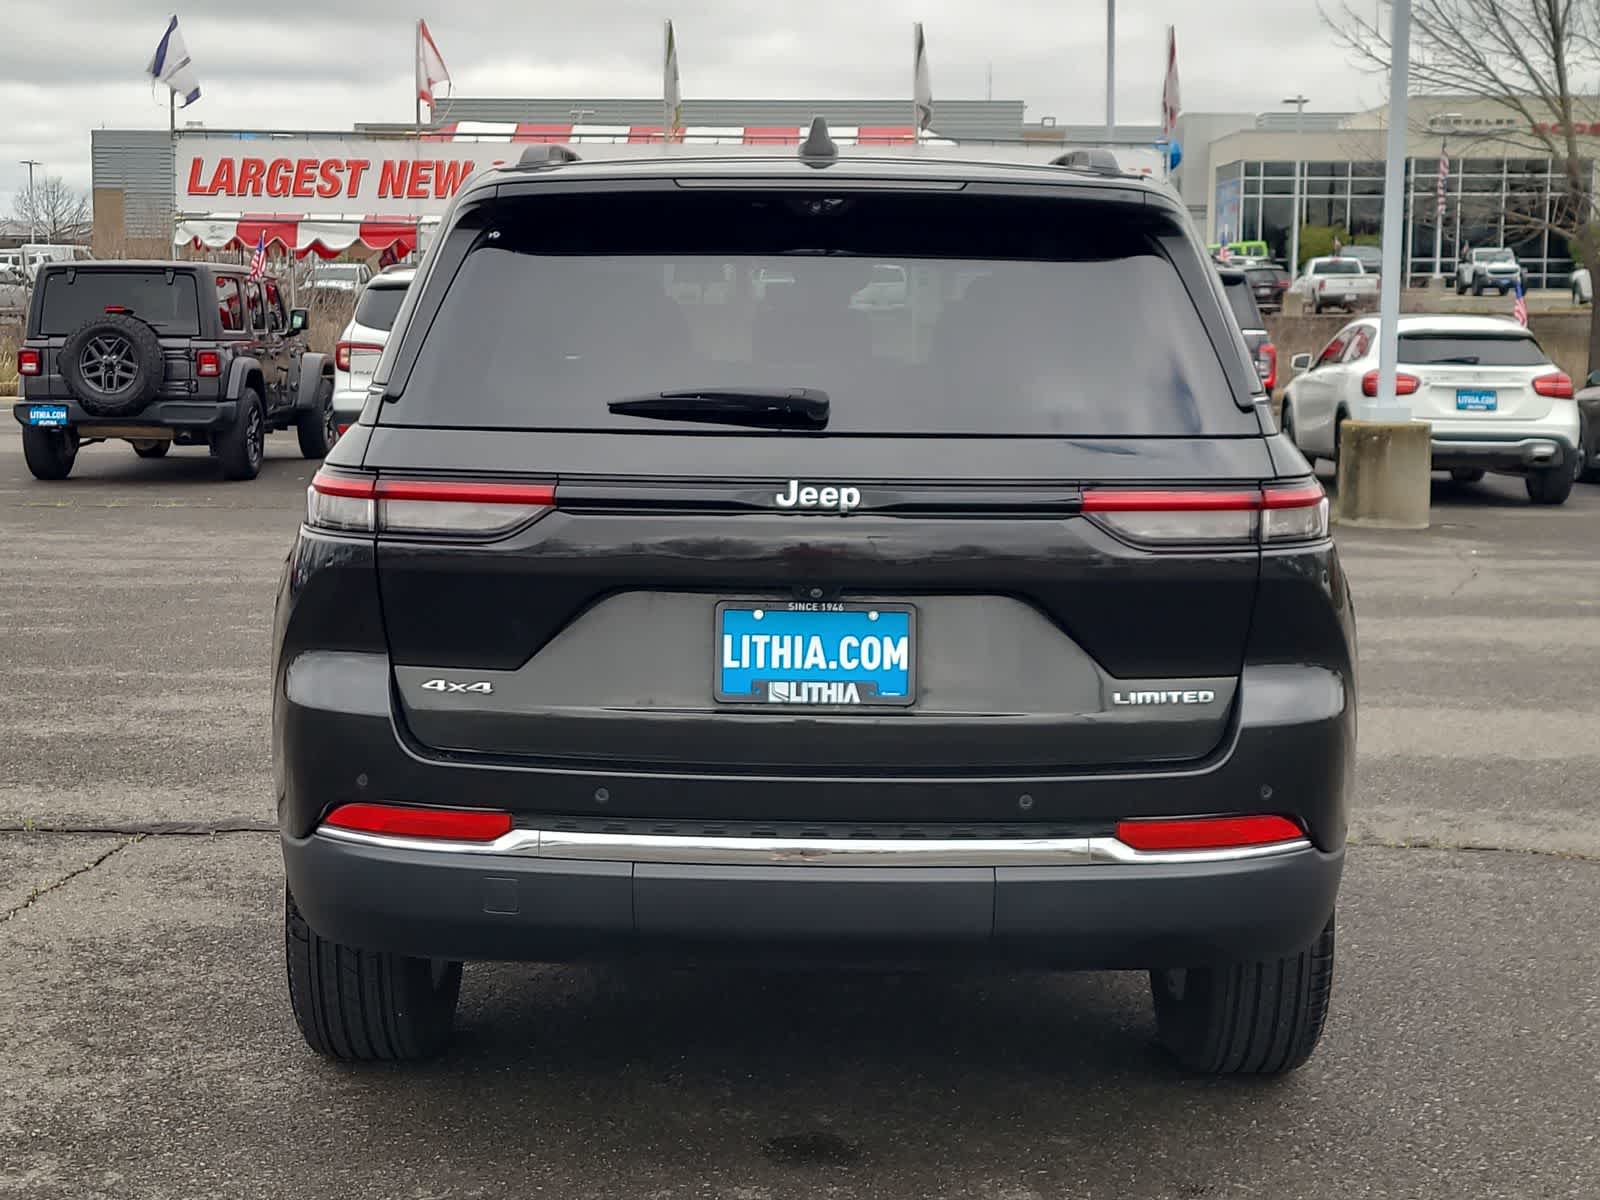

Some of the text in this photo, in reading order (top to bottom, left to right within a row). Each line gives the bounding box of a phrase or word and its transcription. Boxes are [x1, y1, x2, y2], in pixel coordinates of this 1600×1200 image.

[187, 157, 475, 200] LARGEST NEW
[776, 480, 861, 514] Jeep
[788, 602, 845, 612] SINCE 1946
[723, 634, 909, 671] LITHIA.COM
[421, 679, 494, 694] 4x4
[789, 682, 861, 704] LITHIA
[1113, 690, 1215, 705] LIMITED
